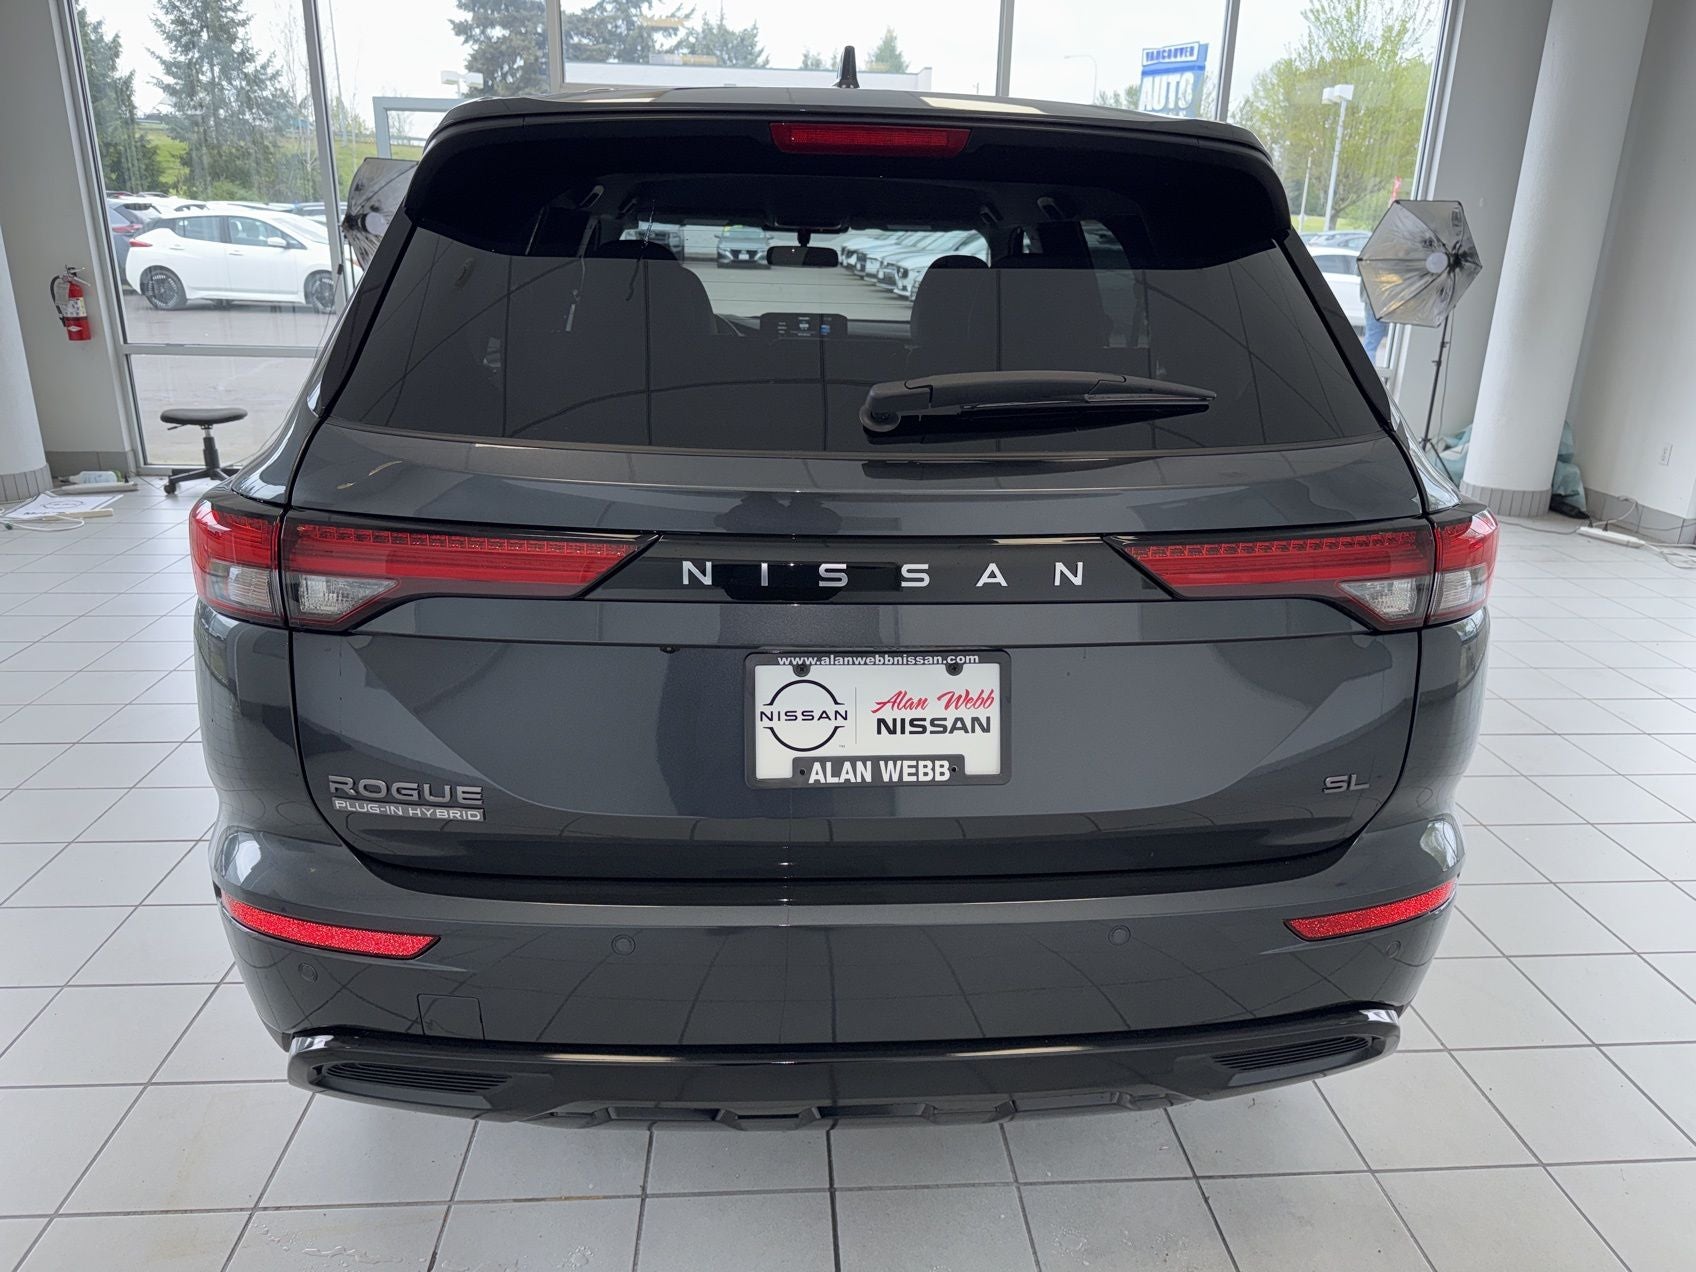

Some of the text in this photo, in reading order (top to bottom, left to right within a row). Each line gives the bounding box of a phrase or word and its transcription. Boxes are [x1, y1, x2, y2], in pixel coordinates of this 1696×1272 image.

[1145, 46, 1195, 62] VANCOUVER
[1138, 71, 1195, 112] AUTO
[682, 560, 1083, 587] NISSAN
[778, 654, 979, 666] www.alanwebbnissan.com
[871, 688, 995, 714] Alan Webb
[760, 710, 848, 722] NISSAN
[876, 716, 991, 735] NISSAN
[808, 760, 950, 784] ALAN WEBB
[328, 775, 484, 805] ROGUE
[1324, 774, 1370, 794] SL
[335, 800, 481, 821] PLUG-IN HYBRID
